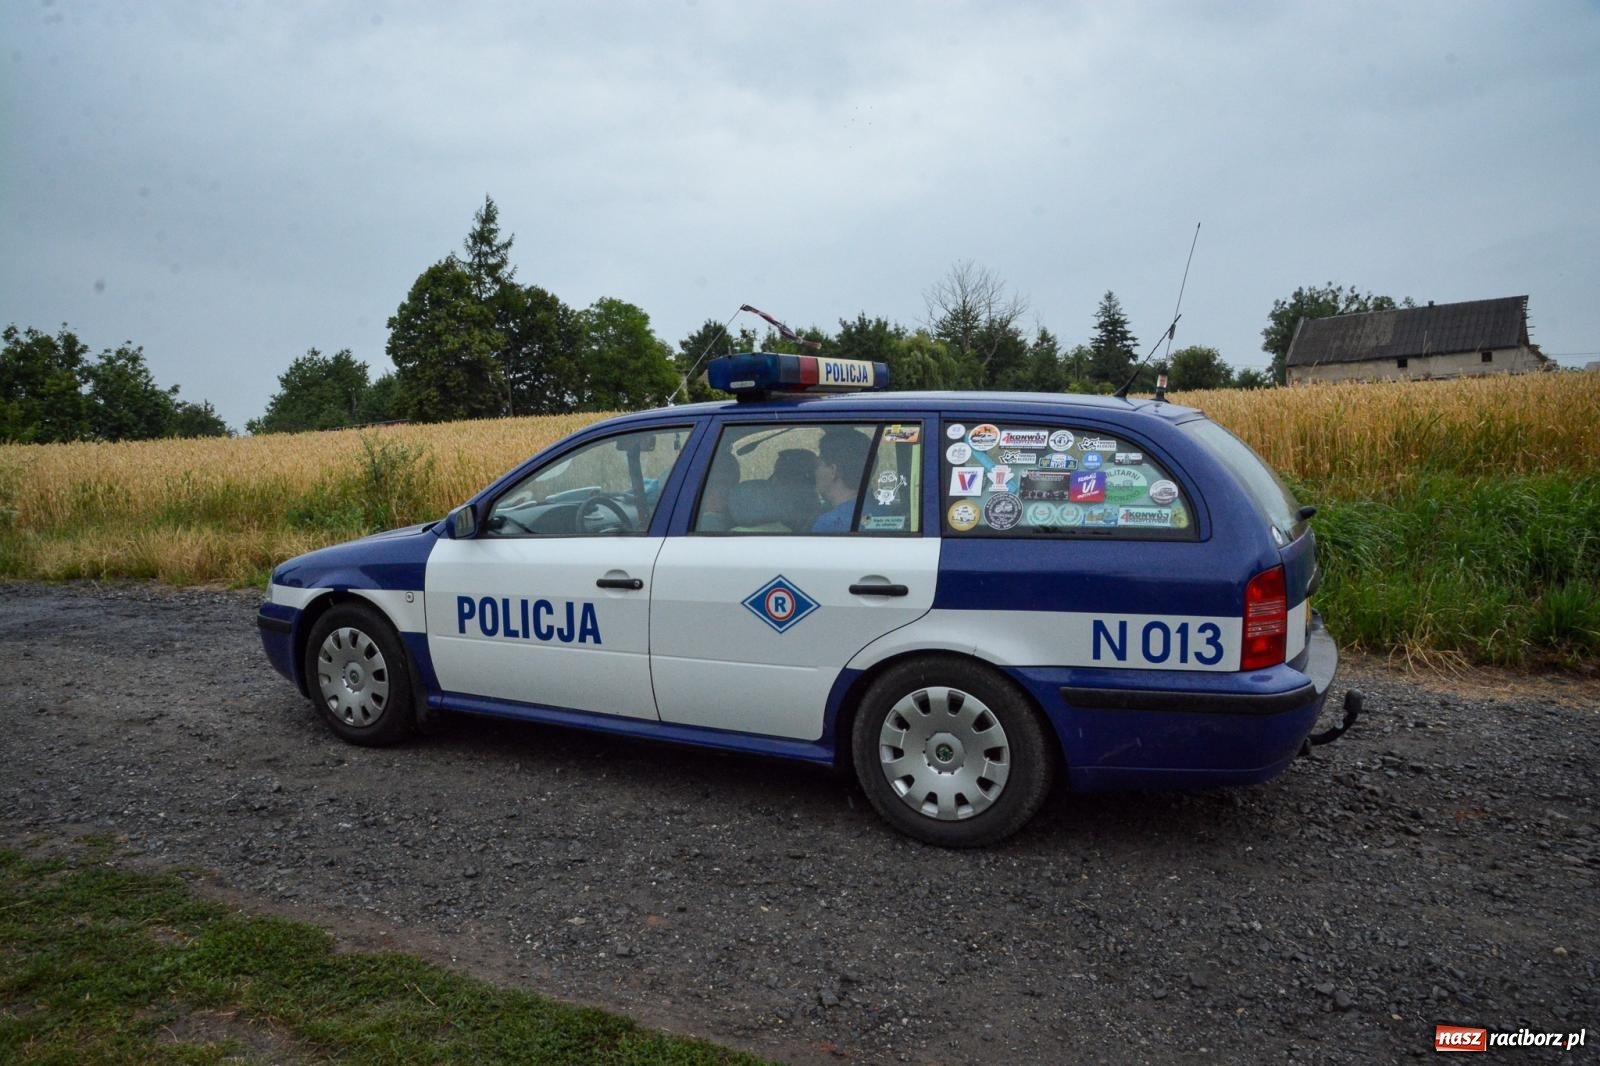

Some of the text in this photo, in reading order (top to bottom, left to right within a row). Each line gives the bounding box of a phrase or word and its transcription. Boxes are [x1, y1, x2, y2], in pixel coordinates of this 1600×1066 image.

[825, 362, 868, 383] POLICJA
[457, 596, 602, 644] POLICJA
[774, 596, 786, 612] R
[1093, 620, 1224, 665] N 013
